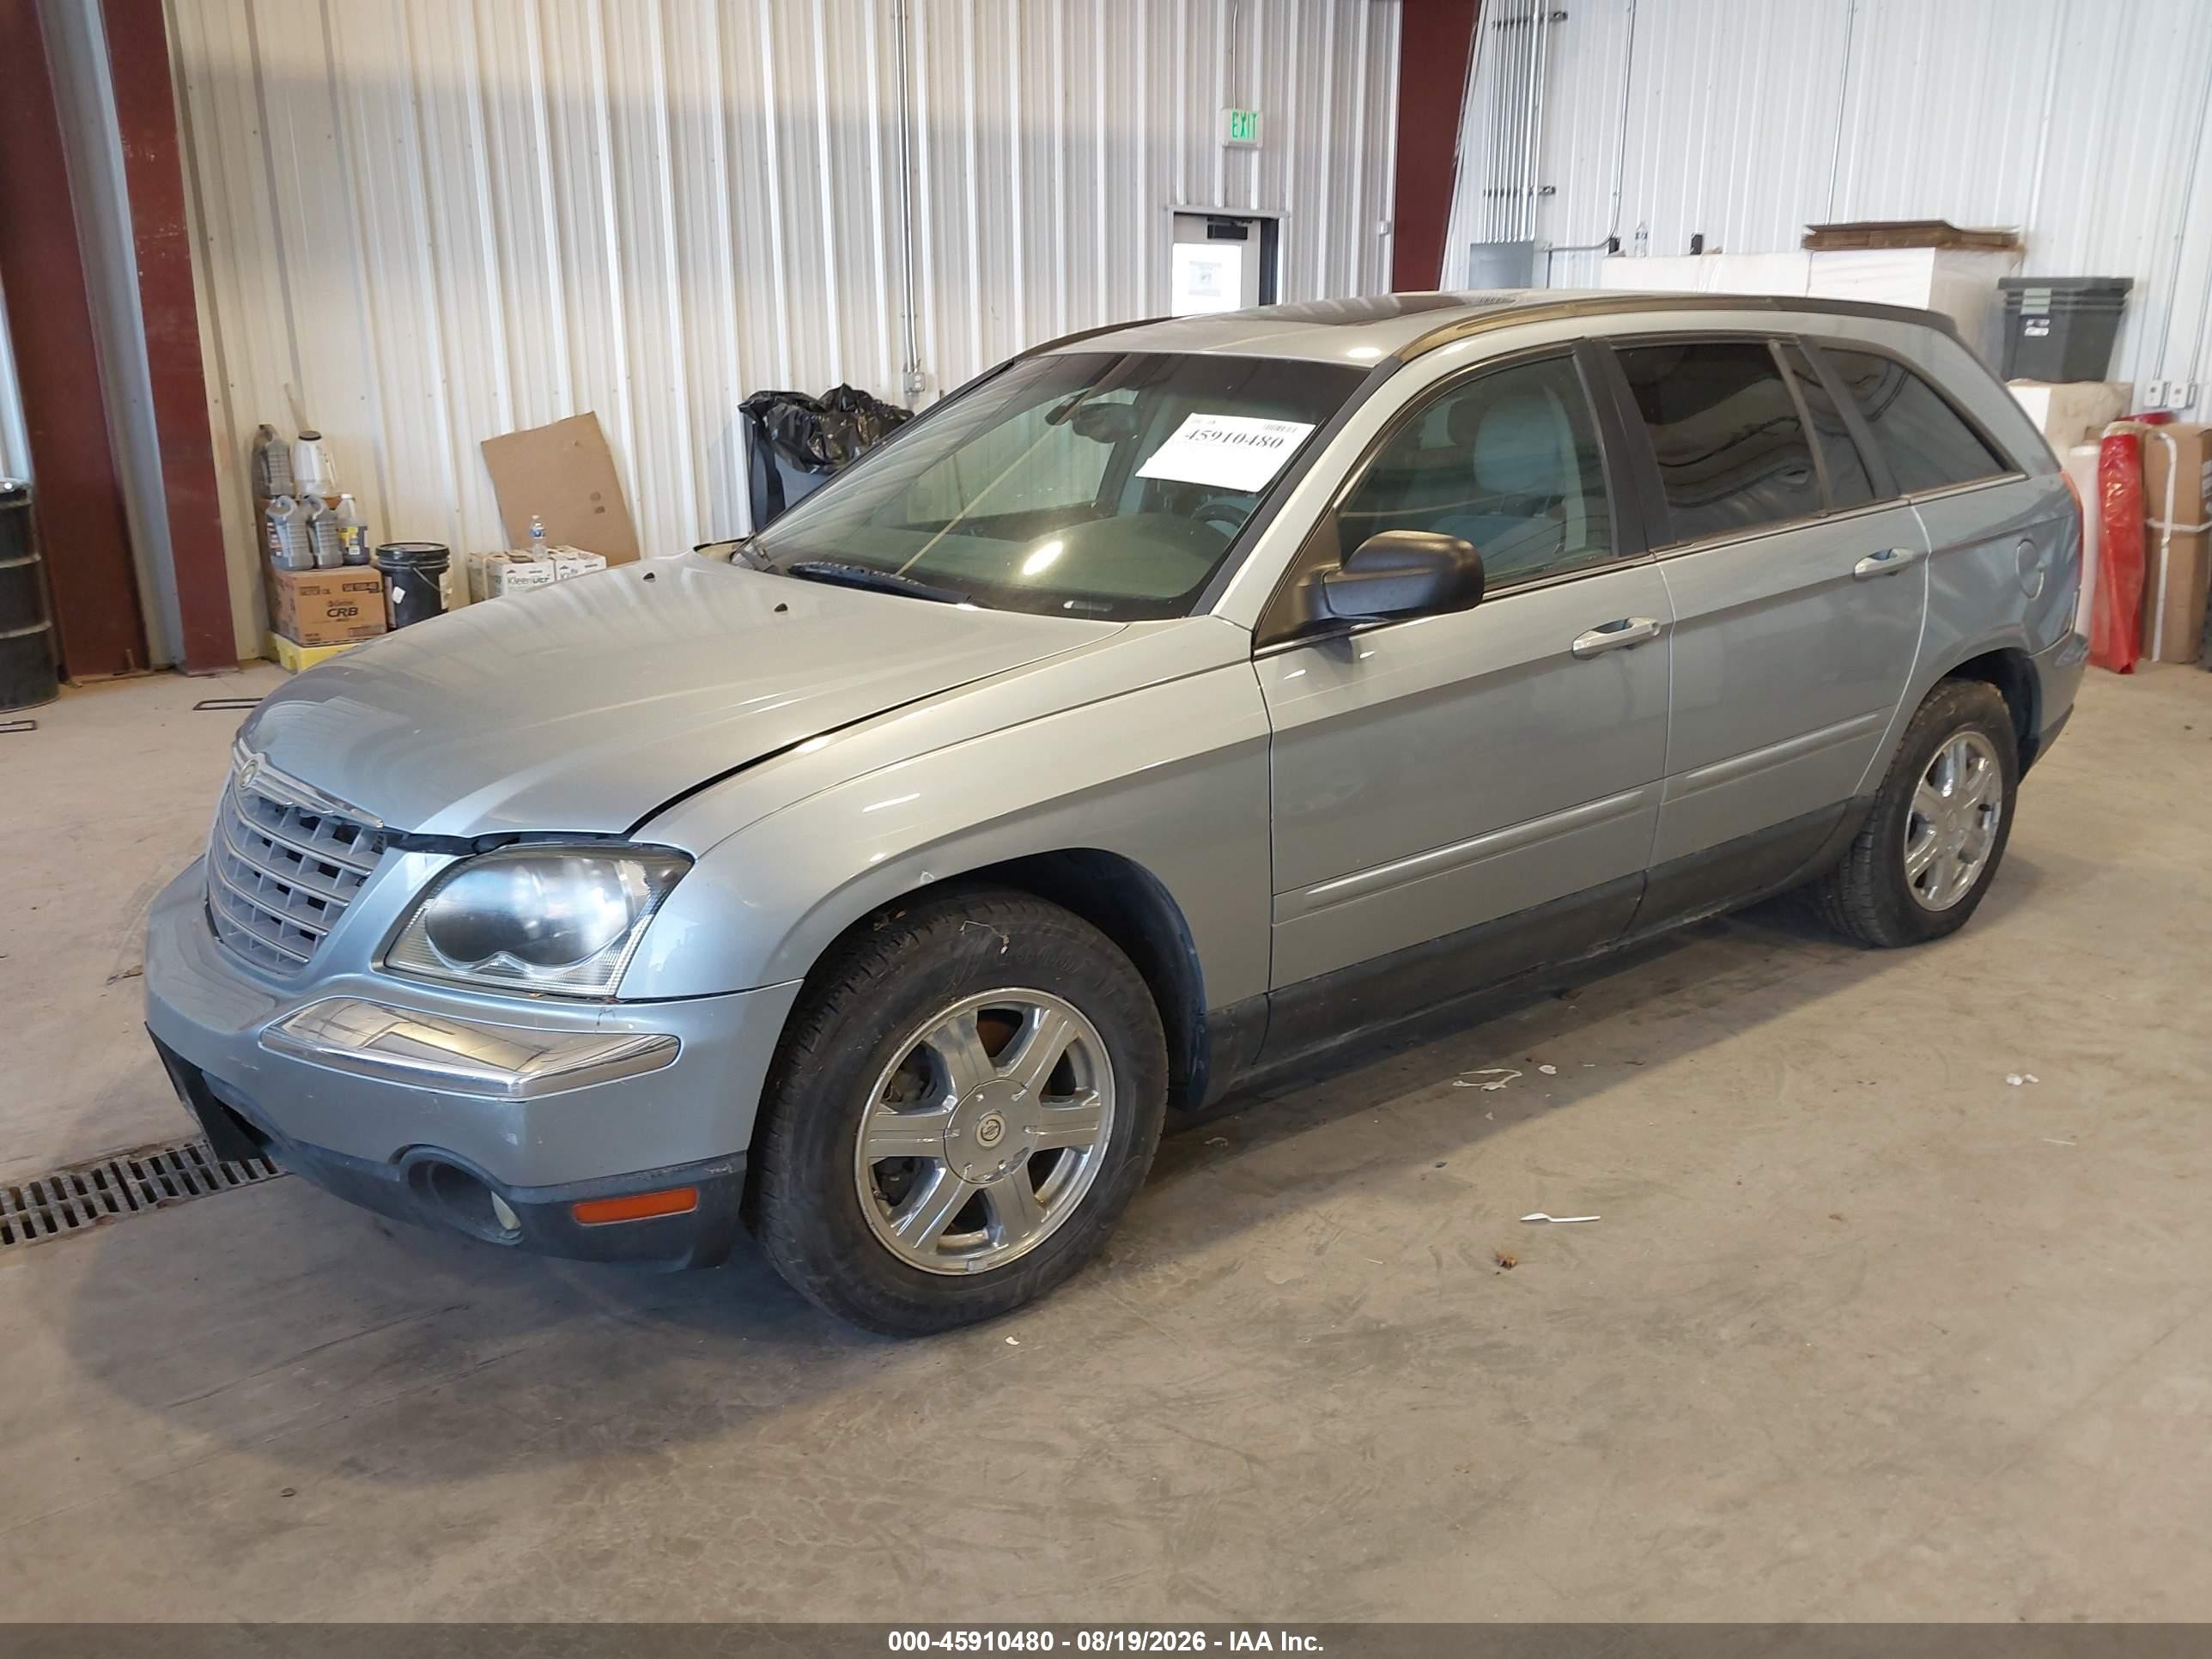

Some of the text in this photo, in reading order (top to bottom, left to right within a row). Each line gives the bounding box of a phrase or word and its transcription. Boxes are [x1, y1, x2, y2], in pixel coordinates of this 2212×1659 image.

[1231, 111, 1257, 139] EXIT
[1184, 428, 1285, 449] 45910480
[326, 607, 359, 617] CRB
